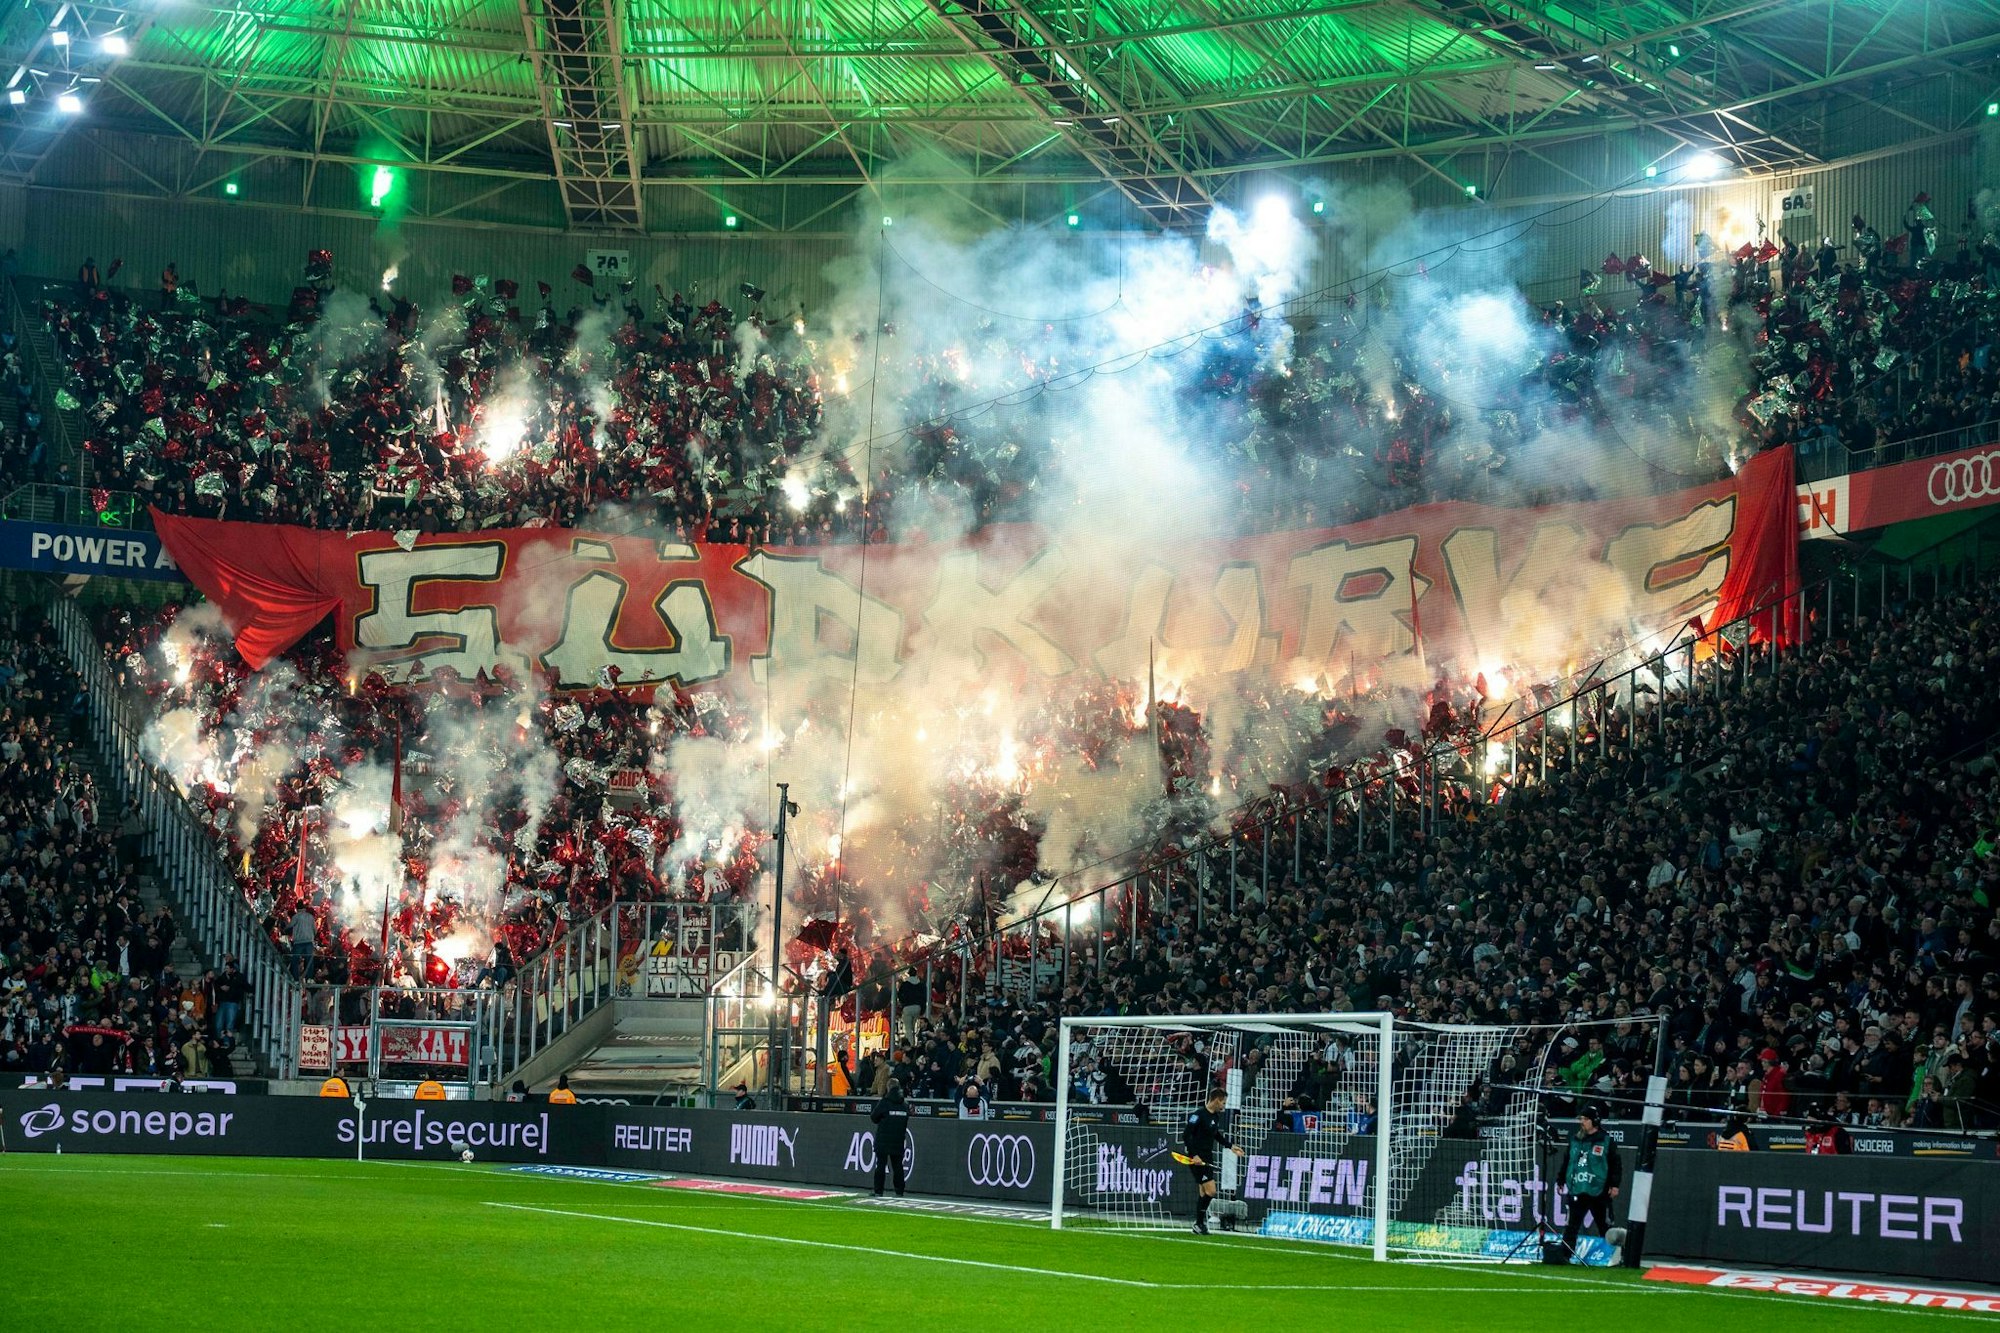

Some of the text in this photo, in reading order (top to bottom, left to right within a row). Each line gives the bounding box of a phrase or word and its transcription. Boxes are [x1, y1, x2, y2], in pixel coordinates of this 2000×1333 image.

[1782, 195, 1804, 211] 6A
[597, 256, 618, 269] 7A
[31, 532, 147, 568] POWER
[71, 1109, 234, 1141] sonepar
[337, 1109, 549, 1154] sure[secure]
[615, 1125, 692, 1153] REUTER
[730, 1123, 779, 1167] PUMA
[1854, 1139, 1894, 1153] KYOCERA
[1932, 1140, 1960, 1149] information
[1096, 1143, 1174, 1203] Bitburger
[1244, 1154, 1368, 1206] ELTEN
[1717, 1185, 1964, 1242] REUTER
